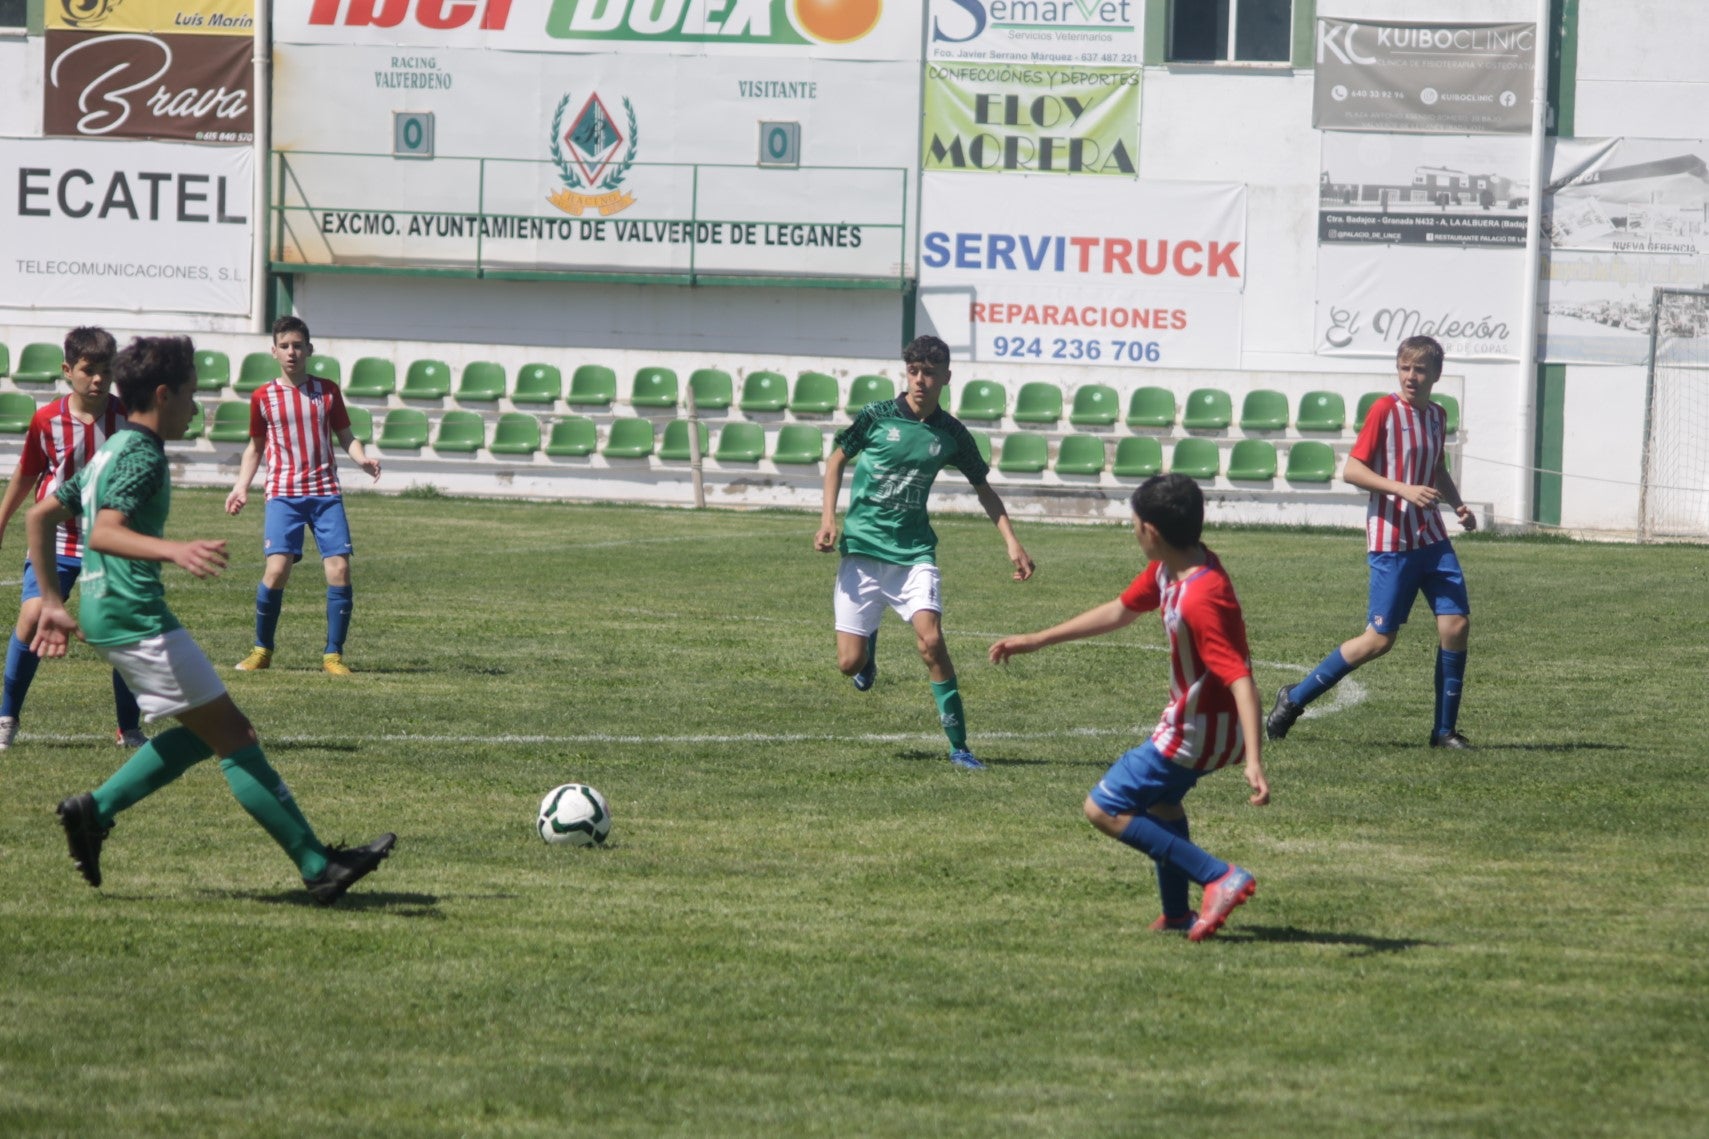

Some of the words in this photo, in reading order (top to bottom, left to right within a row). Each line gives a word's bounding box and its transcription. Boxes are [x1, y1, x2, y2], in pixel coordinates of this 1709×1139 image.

[1007, 30, 1053, 40] Servicios
[1056, 32, 1112, 42] Veterinarios
[1316, 20, 1376, 64] KC
[1377, 27, 1533, 50] KUIBOCLINIC
[391, 56, 437, 69] RACING
[933, 48, 954, 58] Fco.
[957, 49, 986, 59] Javier
[989, 50, 1028, 60] Serrano
[1080, 53, 1098, 62] 637
[1101, 53, 1118, 62] 487
[1120, 54, 1137, 62] 221
[51, 34, 249, 135] Brava
[375, 68, 452, 89] VALVERDEÑO
[738, 80, 817, 99] VISITANTE
[929, 66, 1043, 84] CONFECCIONES
[1046, 71, 1058, 91] Y
[1060, 72, 1140, 86] DEPORTES
[975, 93, 1094, 128] ELOY
[403, 118, 423, 149] 0
[768, 127, 787, 158] 0
[924, 132, 1136, 174] MORERA
[18, 167, 248, 225] ECATEL
[321, 212, 401, 236] EXCMO.
[408, 215, 573, 241] AYUNTAMIENTO
[580, 219, 606, 241] DE
[615, 220, 722, 244] VALVERDE
[730, 222, 757, 245] DE
[765, 222, 862, 248] LEGANÉS
[1462, 218, 1500, 228] ALBUERA
[922, 231, 1242, 278] SERVITRUCK
[17, 259, 214, 281] TELECOMUNICACIONES,
[218, 268, 248, 283] S.L.
[969, 302, 1187, 331] REPARACIONES
[1325, 306, 1361, 348] El
[1373, 307, 1510, 342] Malecón
[993, 336, 1042, 358] 924
[1052, 338, 1102, 360] 236
[1111, 340, 1160, 362] 706
